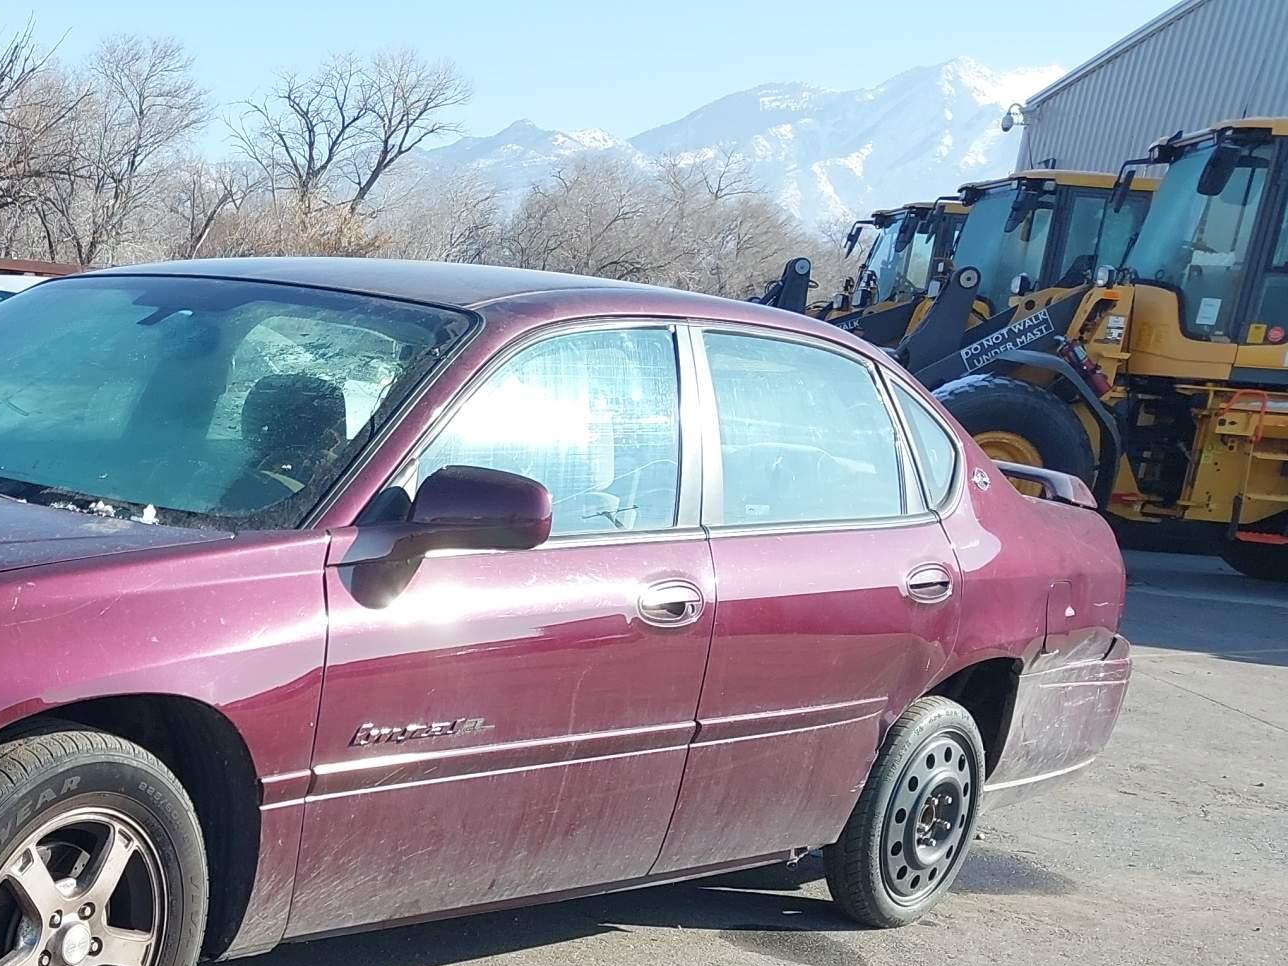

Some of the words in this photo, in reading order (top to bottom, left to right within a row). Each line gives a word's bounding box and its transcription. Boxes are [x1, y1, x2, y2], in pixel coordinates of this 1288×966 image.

[964, 345, 981, 359] DO
[982, 327, 1009, 349] NOT
[1011, 311, 1048, 334] WALK
[974, 342, 1016, 367] UNDER
[1016, 324, 1047, 347] MAST
